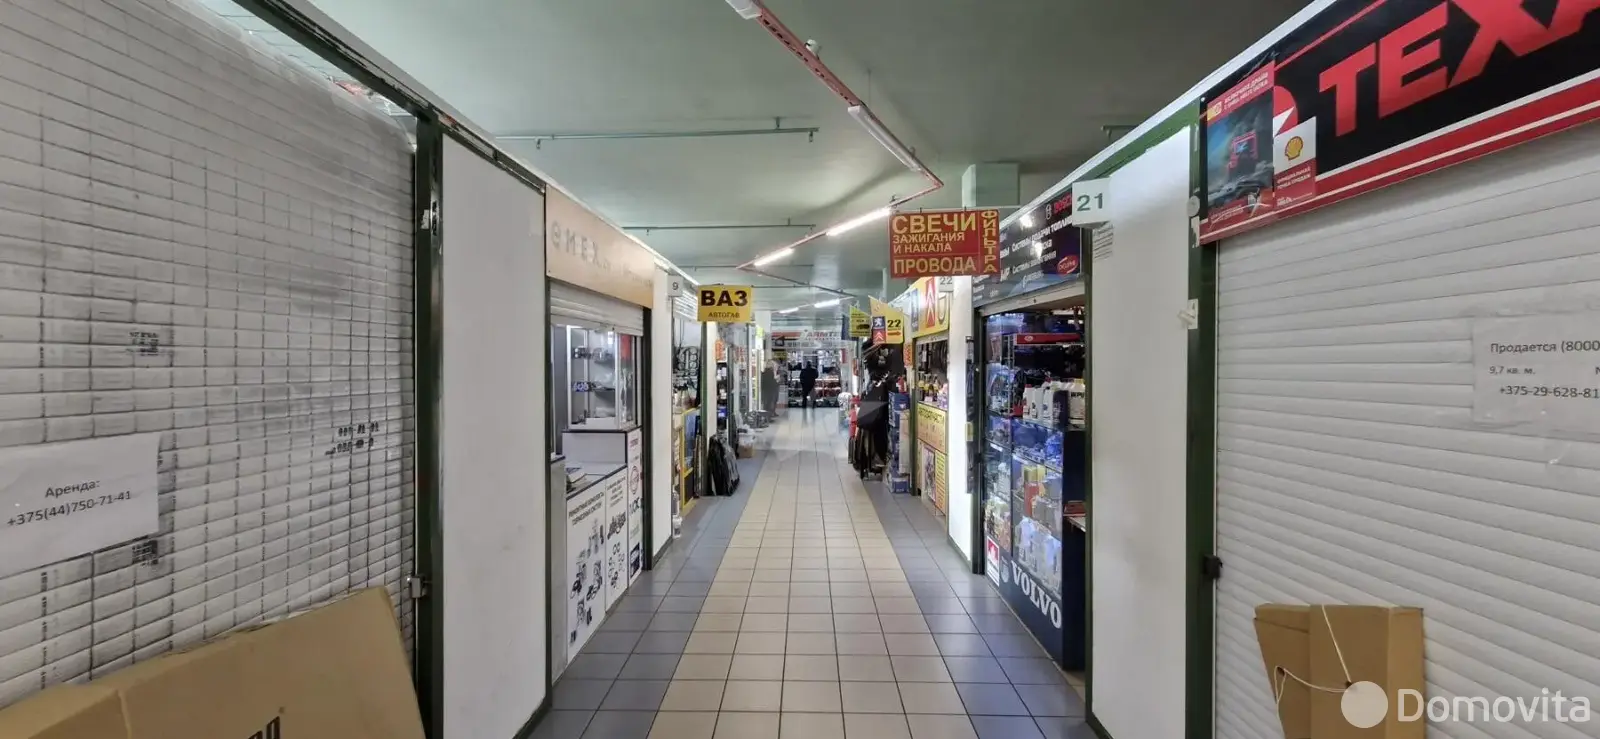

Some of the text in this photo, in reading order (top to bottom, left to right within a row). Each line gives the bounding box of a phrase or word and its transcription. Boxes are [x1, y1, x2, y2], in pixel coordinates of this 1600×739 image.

[1076, 192, 1103, 212] 21
[892, 212, 976, 234] СВЕЧИ
[892, 231, 965, 244] ЗАЖИГАНИЯ
[981, 209, 997, 273] ФИЛЬТРА
[893, 243, 952, 254] И НАКАЛА
[893, 256, 976, 275] ПРОВОДА
[672, 281, 679, 290] 9
[939, 276, 953, 285] 22
[700, 290, 748, 307] ВАЗ
[887, 319, 901, 328] 22
[1490, 343, 1557, 354] Продается
[1489, 365, 1504, 375] 9,7
[1499, 386, 1600, 399] +375-29-628-81
[45, 480, 100, 498] Аренда:
[7, 490, 131, 526] +375(44)750-71-41
[1011, 559, 1062, 629] VOLVO
